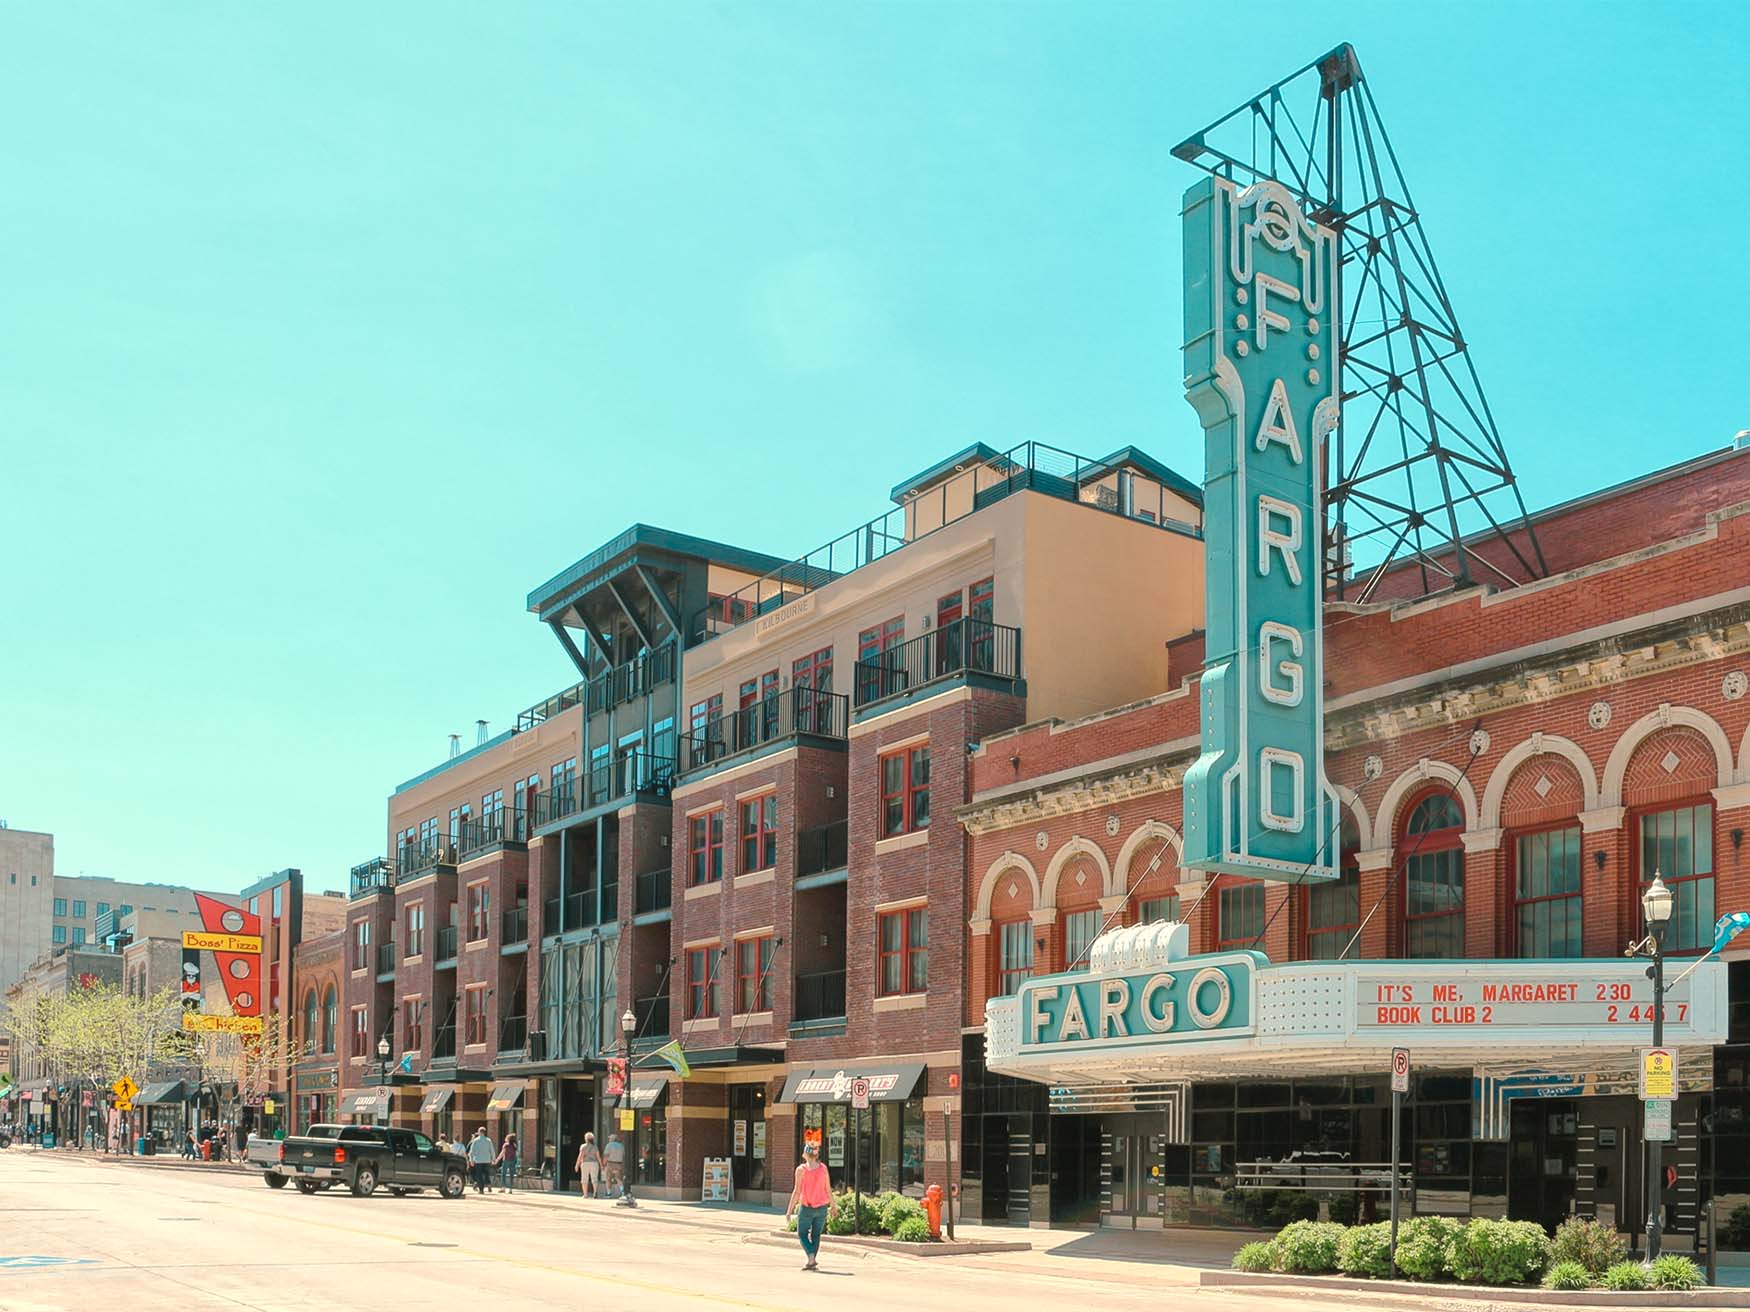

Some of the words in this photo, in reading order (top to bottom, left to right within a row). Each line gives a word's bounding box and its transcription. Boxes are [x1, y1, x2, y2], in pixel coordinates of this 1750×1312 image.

[1254, 271, 1304, 833] FARGO
[762, 600, 808, 630] KILBOURNE
[228, 937, 258, 951] Pizza
[1031, 967, 1231, 1043] FARGO
[1377, 985, 1413, 1002] IT'S
[1432, 985, 1463, 1003] ME,
[1482, 984, 1578, 1002] MARGARET
[1377, 1006, 1421, 1024] BOOK
[1431, 1006, 1476, 1024] CLUB
[1481, 1006, 1493, 1024] 2
